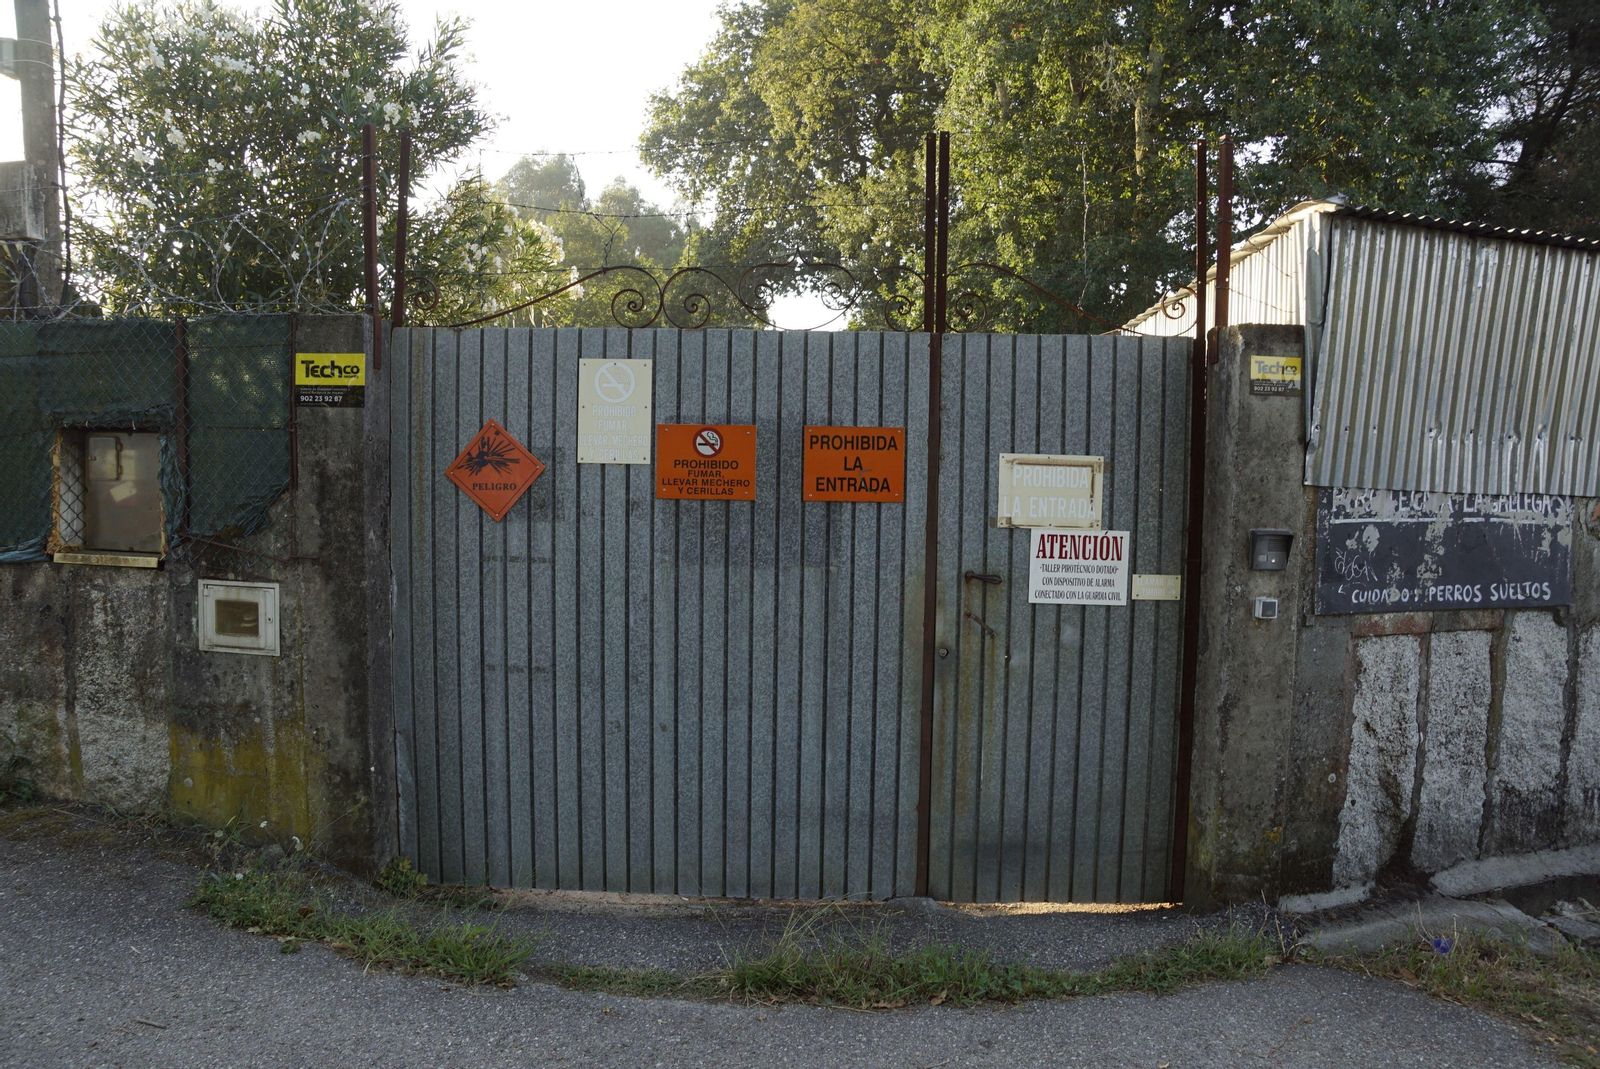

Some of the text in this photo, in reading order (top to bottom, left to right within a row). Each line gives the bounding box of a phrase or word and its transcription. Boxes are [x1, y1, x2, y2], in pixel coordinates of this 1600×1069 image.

[592, 404, 637, 418] PROHIBIDO
[580, 434, 649, 448] LLEVAR MECHERO
[809, 434, 898, 451] PROHIBIDA
[589, 448, 639, 461] Y CERILLAS
[673, 459, 739, 470] PROHIBIDO
[843, 456, 863, 471] LA
[687, 470, 725, 478] FUMAR,
[1012, 465, 1089, 489] PROHIBIDA
[472, 482, 517, 491] PELIGRO
[661, 478, 751, 487] LLEVAR MECHERO
[815, 476, 891, 493] ENTRADA
[686, 487, 734, 495] CERILLAS
[1002, 495, 1097, 519] LA ENTRADA
[1035, 531, 1124, 561] ATENCIÓN
[1042, 576, 1115, 588] CON DISPOSITIVO DE ALARMA
[1034, 590, 1122, 601] CONECTADO CON LA GUARDIA CIVIL
[1428, 584, 1482, 602] PERROS
[1490, 581, 1551, 601] SUELTOS
